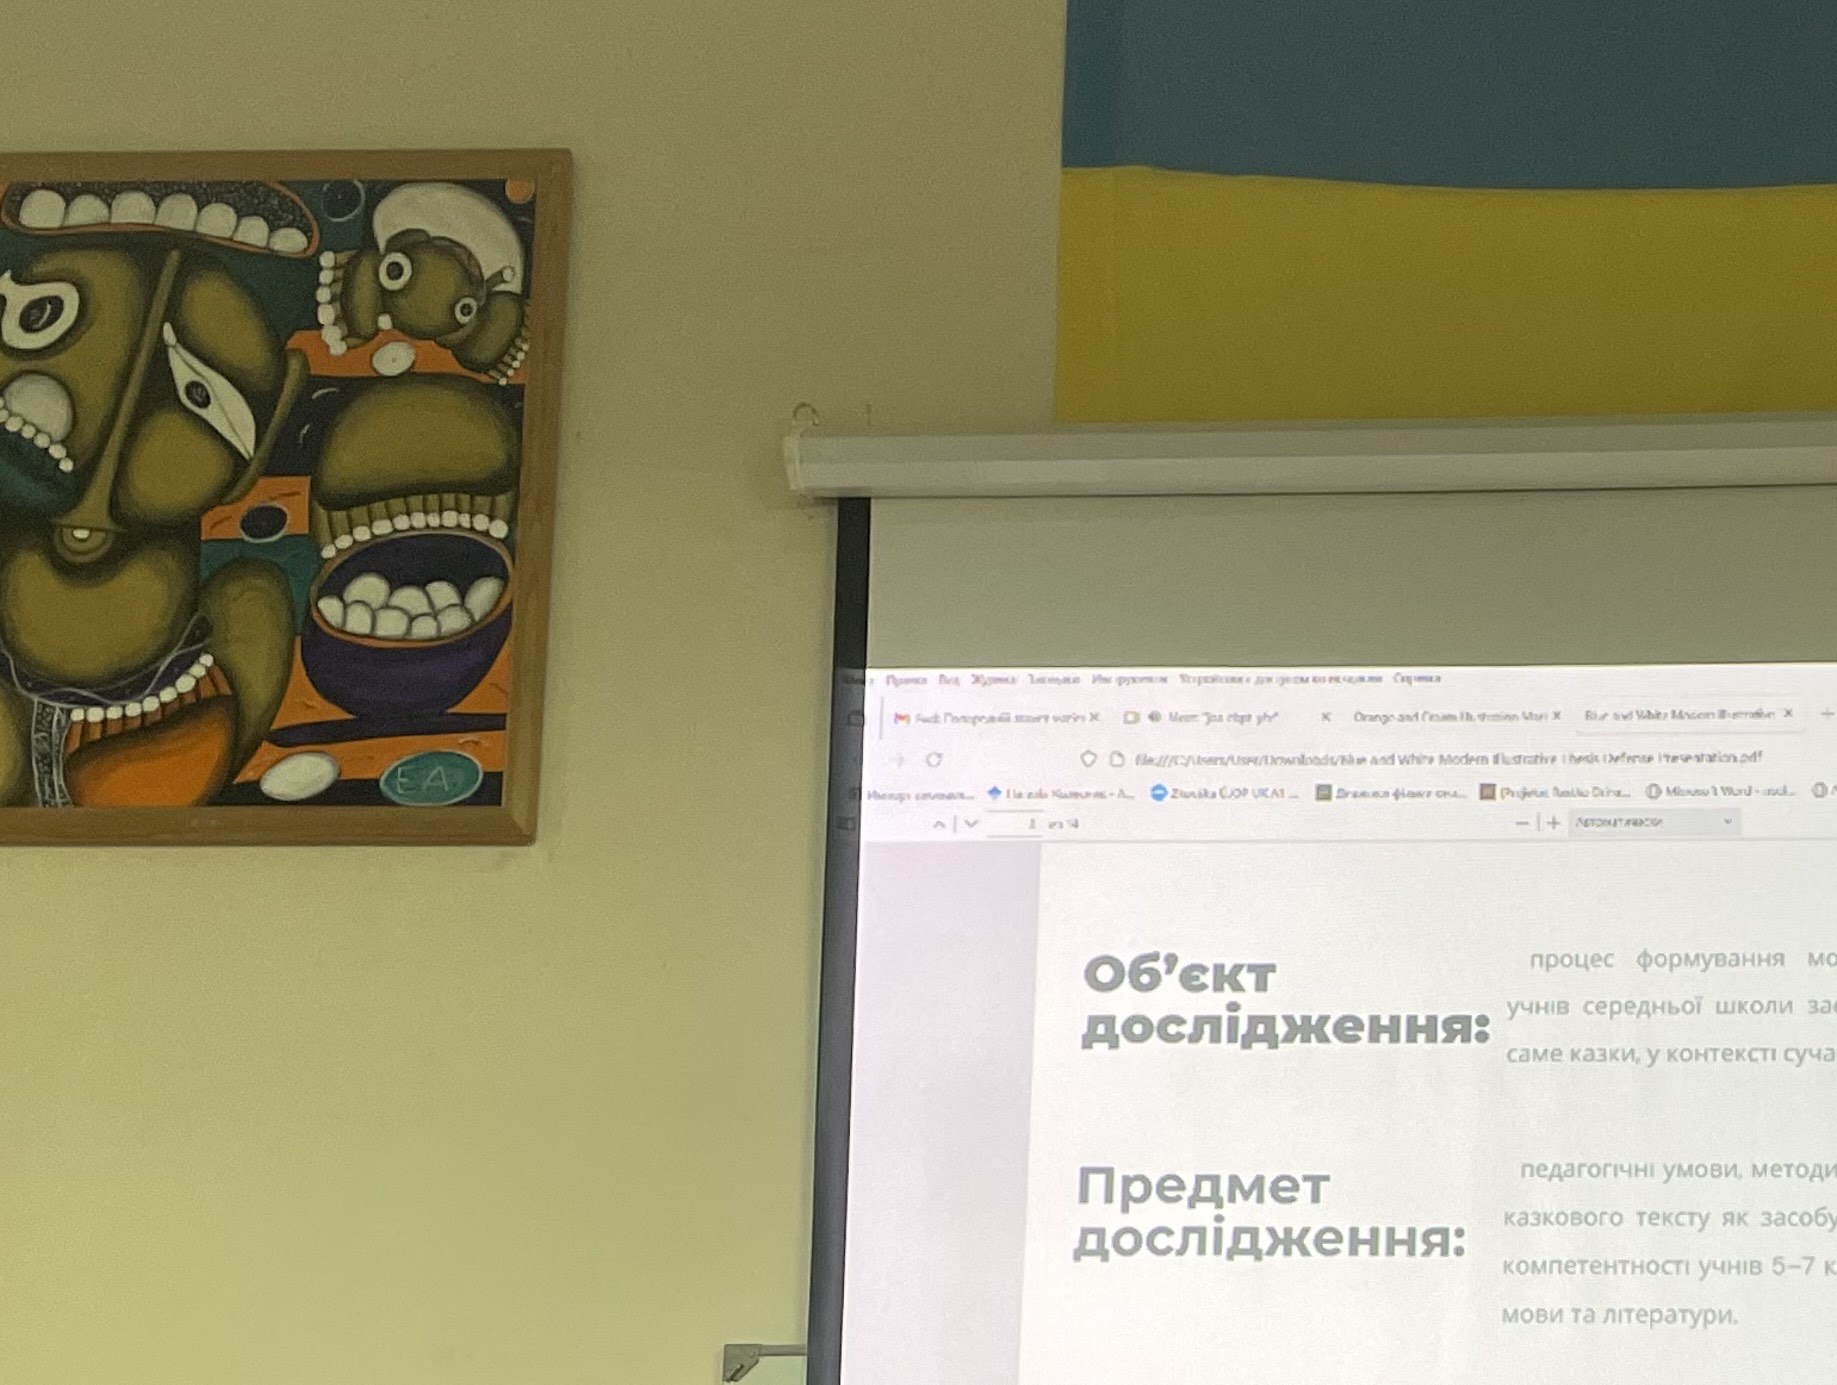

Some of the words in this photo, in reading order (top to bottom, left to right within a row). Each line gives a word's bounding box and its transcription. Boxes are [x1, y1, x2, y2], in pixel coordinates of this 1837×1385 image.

[1084, 950, 1277, 994] Об’єкт
[1530, 950, 1615, 972] процес
[1636, 947, 1786, 972] формування
[1506, 998, 1570, 1020] учнів
[1583, 994, 1704, 1020] середньої
[1715, 998, 1793, 1015] школи
[1081, 1001, 1491, 1050] дослідження:
[1506, 1047, 1564, 1063] саме
[1570, 1046, 1641, 1065] казки,
[1648, 1047, 1661, 1067] у
[1667, 1046, 1777, 1063] контексті
[1520, 1160, 1655, 1182] педагогічні
[1662, 1161, 1743, 1183] умови,
[1078, 1166, 1331, 1214] Предмет
[1504, 1209, 1624, 1226] казкового
[1635, 1209, 1711, 1231] тексту
[1722, 1209, 1749, 1226] як
[1073, 1214, 1466, 1262] дослідження:
[1503, 1257, 1690, 1276] компетентності
[1698, 1257, 1763, 1280] учнів
[1771, 1255, 1816, 1276] 5–7
[1501, 1305, 1565, 1324] мови
[1571, 1305, 1596, 1324] та
[1602, 1304, 1739, 1330] літератури.
